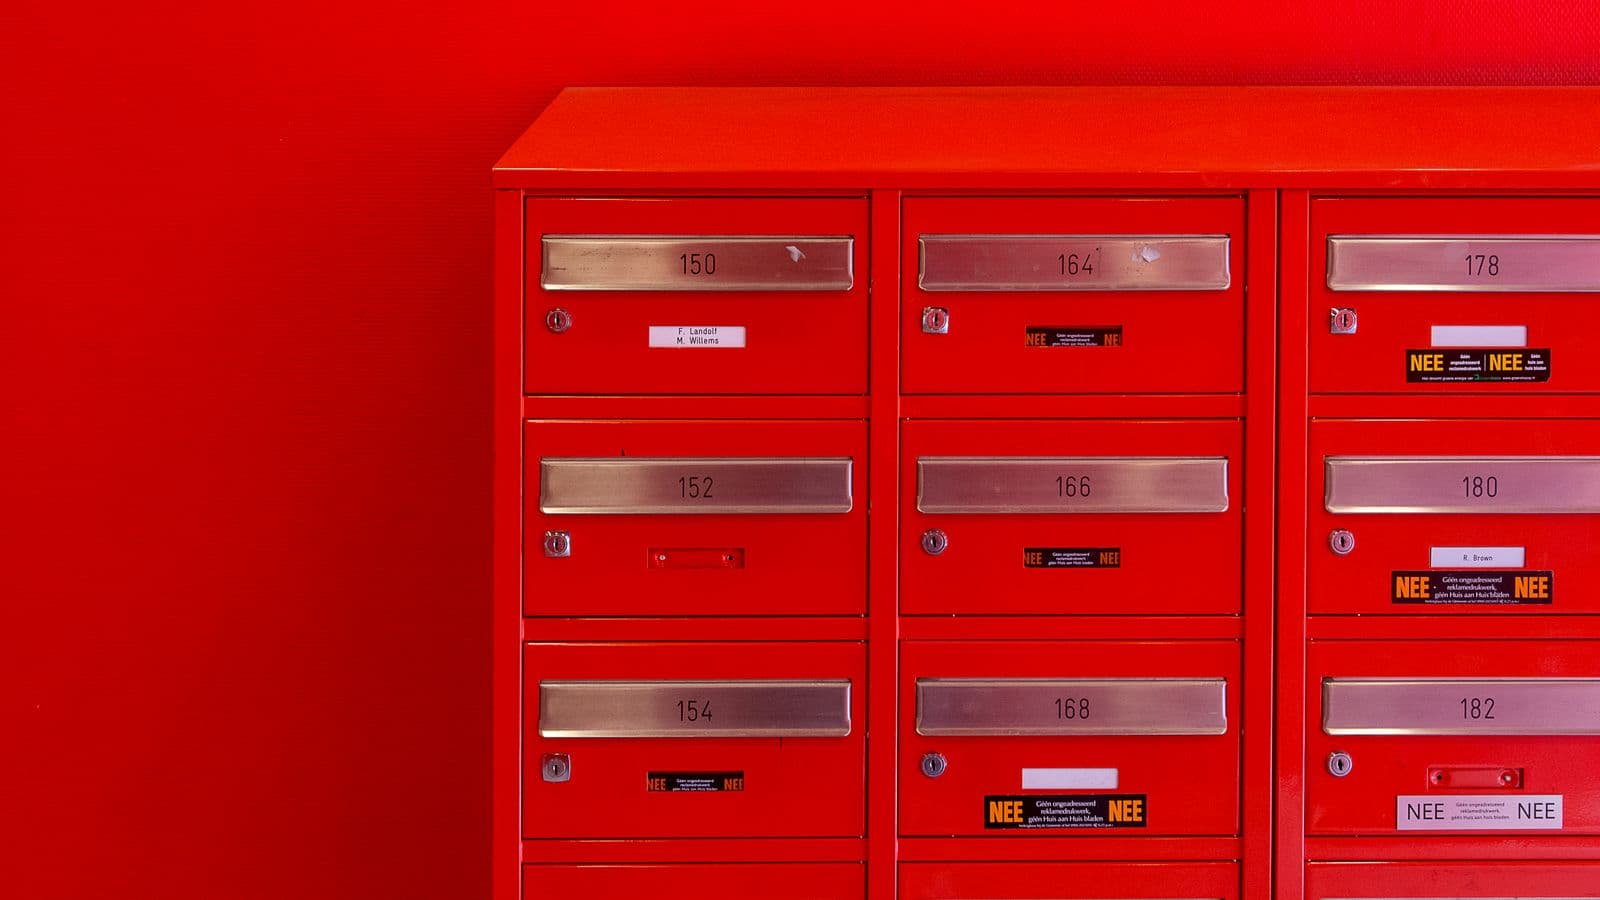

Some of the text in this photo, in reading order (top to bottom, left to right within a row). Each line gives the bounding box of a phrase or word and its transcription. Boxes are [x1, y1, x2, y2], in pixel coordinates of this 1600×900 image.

[680, 253, 716, 275] 150
[1058, 253, 1093, 275] 164
[1465, 254, 1499, 276] 178
[689, 337, 719, 345] Willems
[1026, 333, 1046, 346] NEE
[1410, 354, 1444, 371] NEE
[1489, 354, 1523, 371] NEE
[679, 476, 714, 498] 152
[1055, 476, 1091, 498] 166
[1462, 476, 1498, 498] 180
[1473, 554, 1493, 562] Brown
[1396, 576, 1430, 599] NEE
[1514, 576, 1549, 599] NEE
[677, 700, 713, 722] 154
[1054, 698, 1090, 720] 168
[1460, 697, 1495, 719] 182
[989, 801, 1024, 823] NEE
[1108, 800, 1143, 823] NEE
[1407, 803, 1445, 820] NEE
[1518, 802, 1556, 820] NEE
